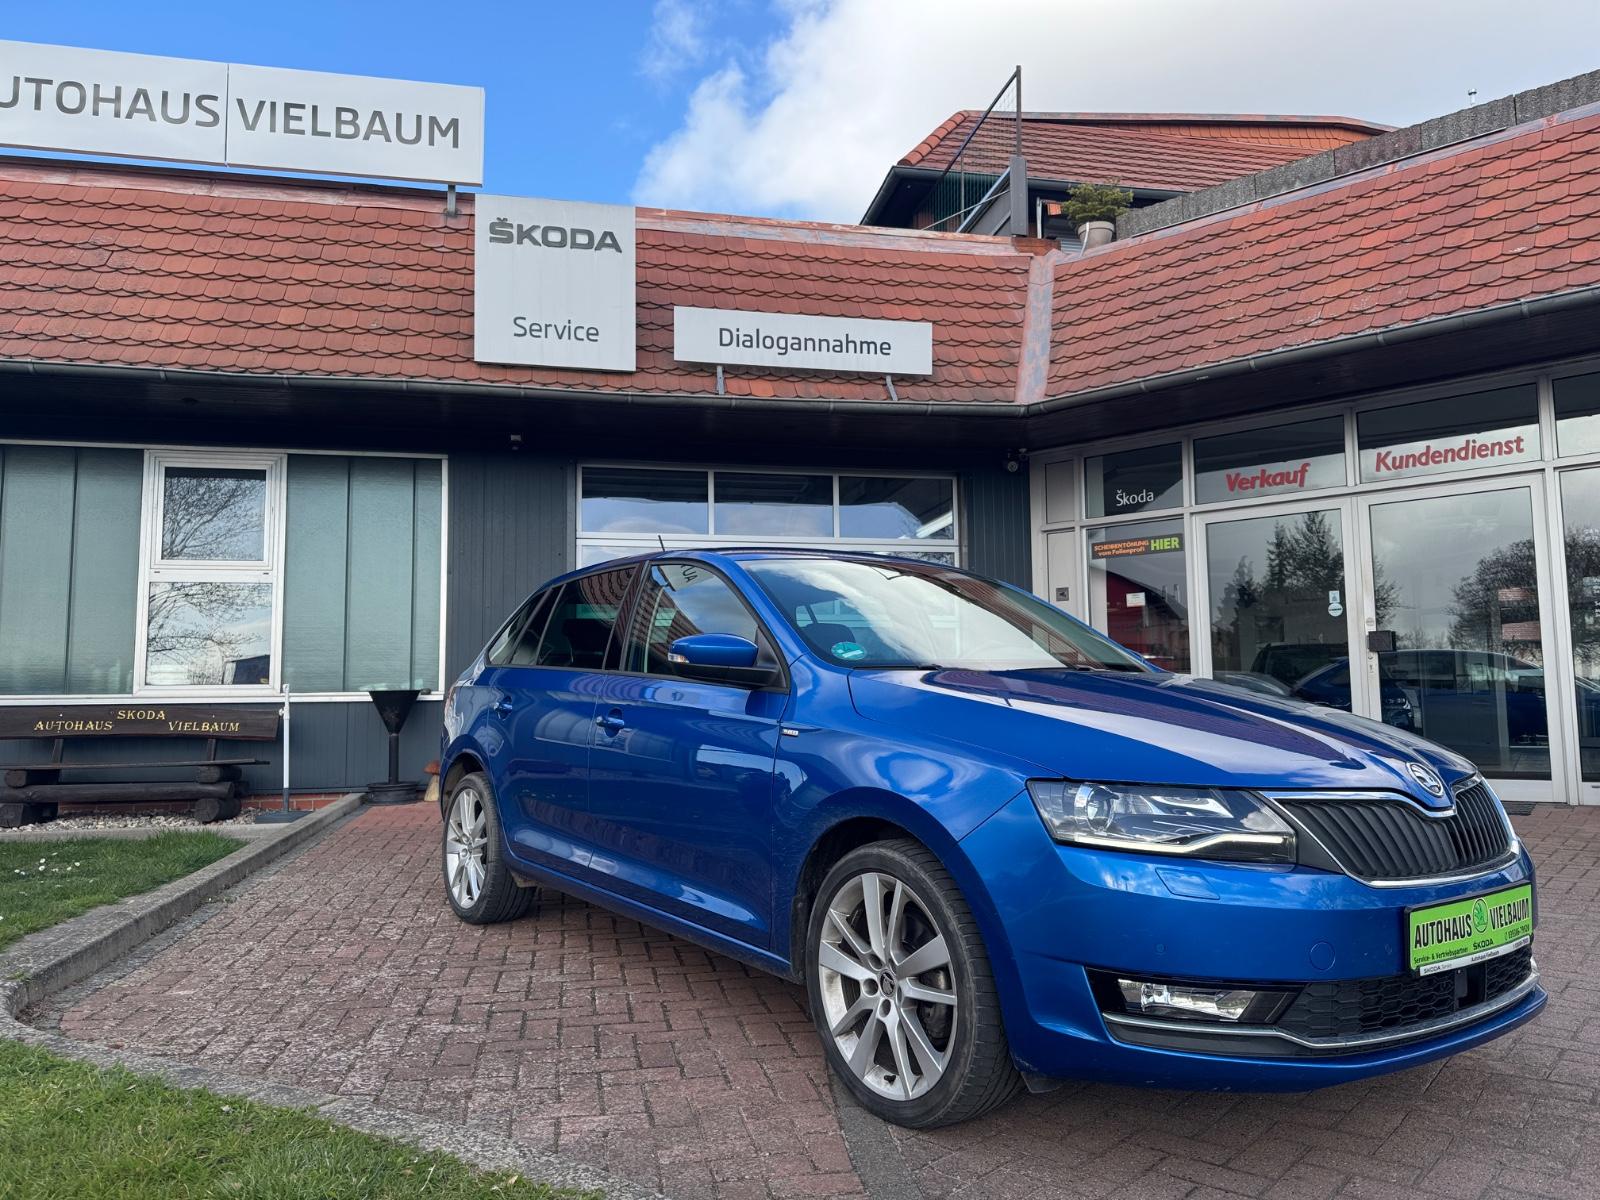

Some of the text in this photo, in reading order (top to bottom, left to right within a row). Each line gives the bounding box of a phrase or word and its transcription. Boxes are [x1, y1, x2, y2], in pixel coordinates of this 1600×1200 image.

[236, 98, 459, 149] VIELBAUM
[489, 217, 623, 254] ŠKODA
[513, 316, 599, 342] Service
[719, 327, 892, 356] Dialogannahme
[1375, 435, 1525, 473] Kundendienst
[1226, 462, 1312, 492] Verkauf
[1116, 489, 1154, 506] Škoda
[1151, 537, 1180, 551] HIER
[34, 721, 240, 732] AUTOHAUS VIELBAUM
[117, 710, 166, 720] SKODA
[1414, 914, 1472, 949] AUTOHAUS
[1489, 898, 1529, 930] VIELBAUM
